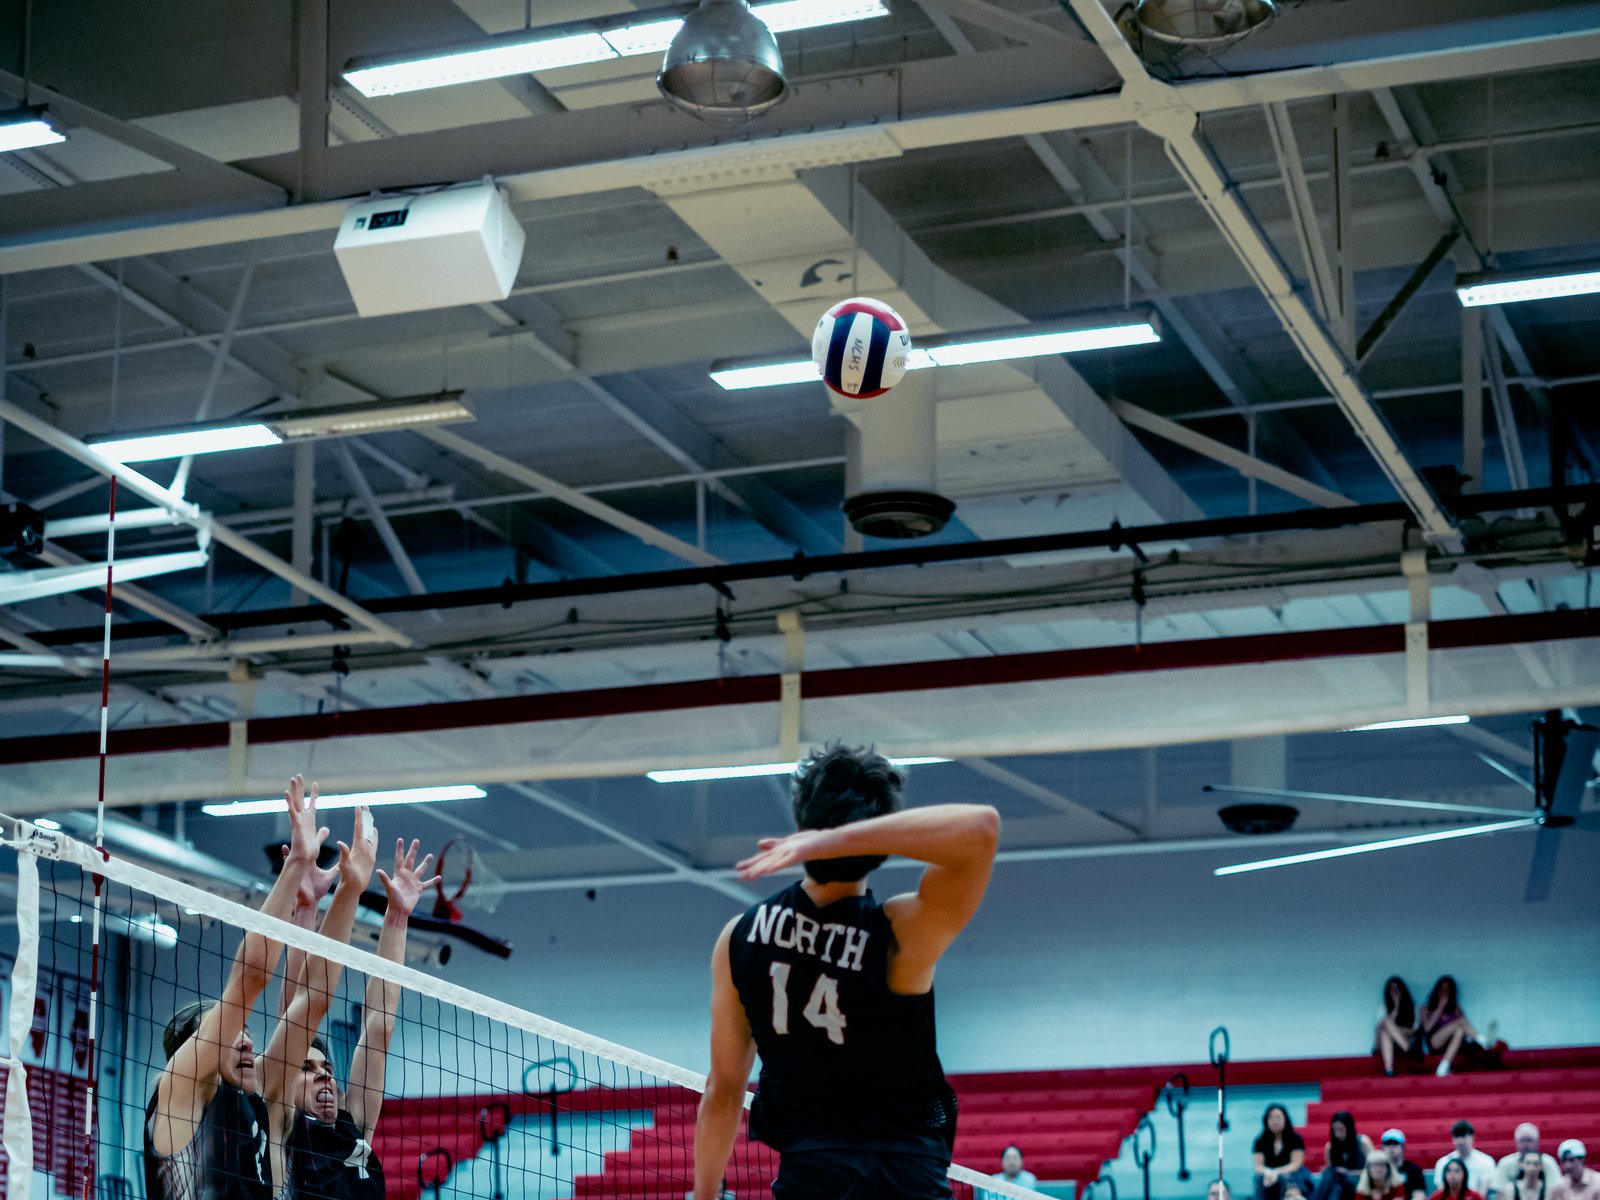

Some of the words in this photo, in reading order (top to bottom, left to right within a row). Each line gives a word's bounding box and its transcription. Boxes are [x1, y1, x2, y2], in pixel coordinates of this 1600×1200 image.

[848, 337, 864, 372] NCHS
[747, 904, 870, 971] NORTH
[769, 961, 847, 1045] 14
